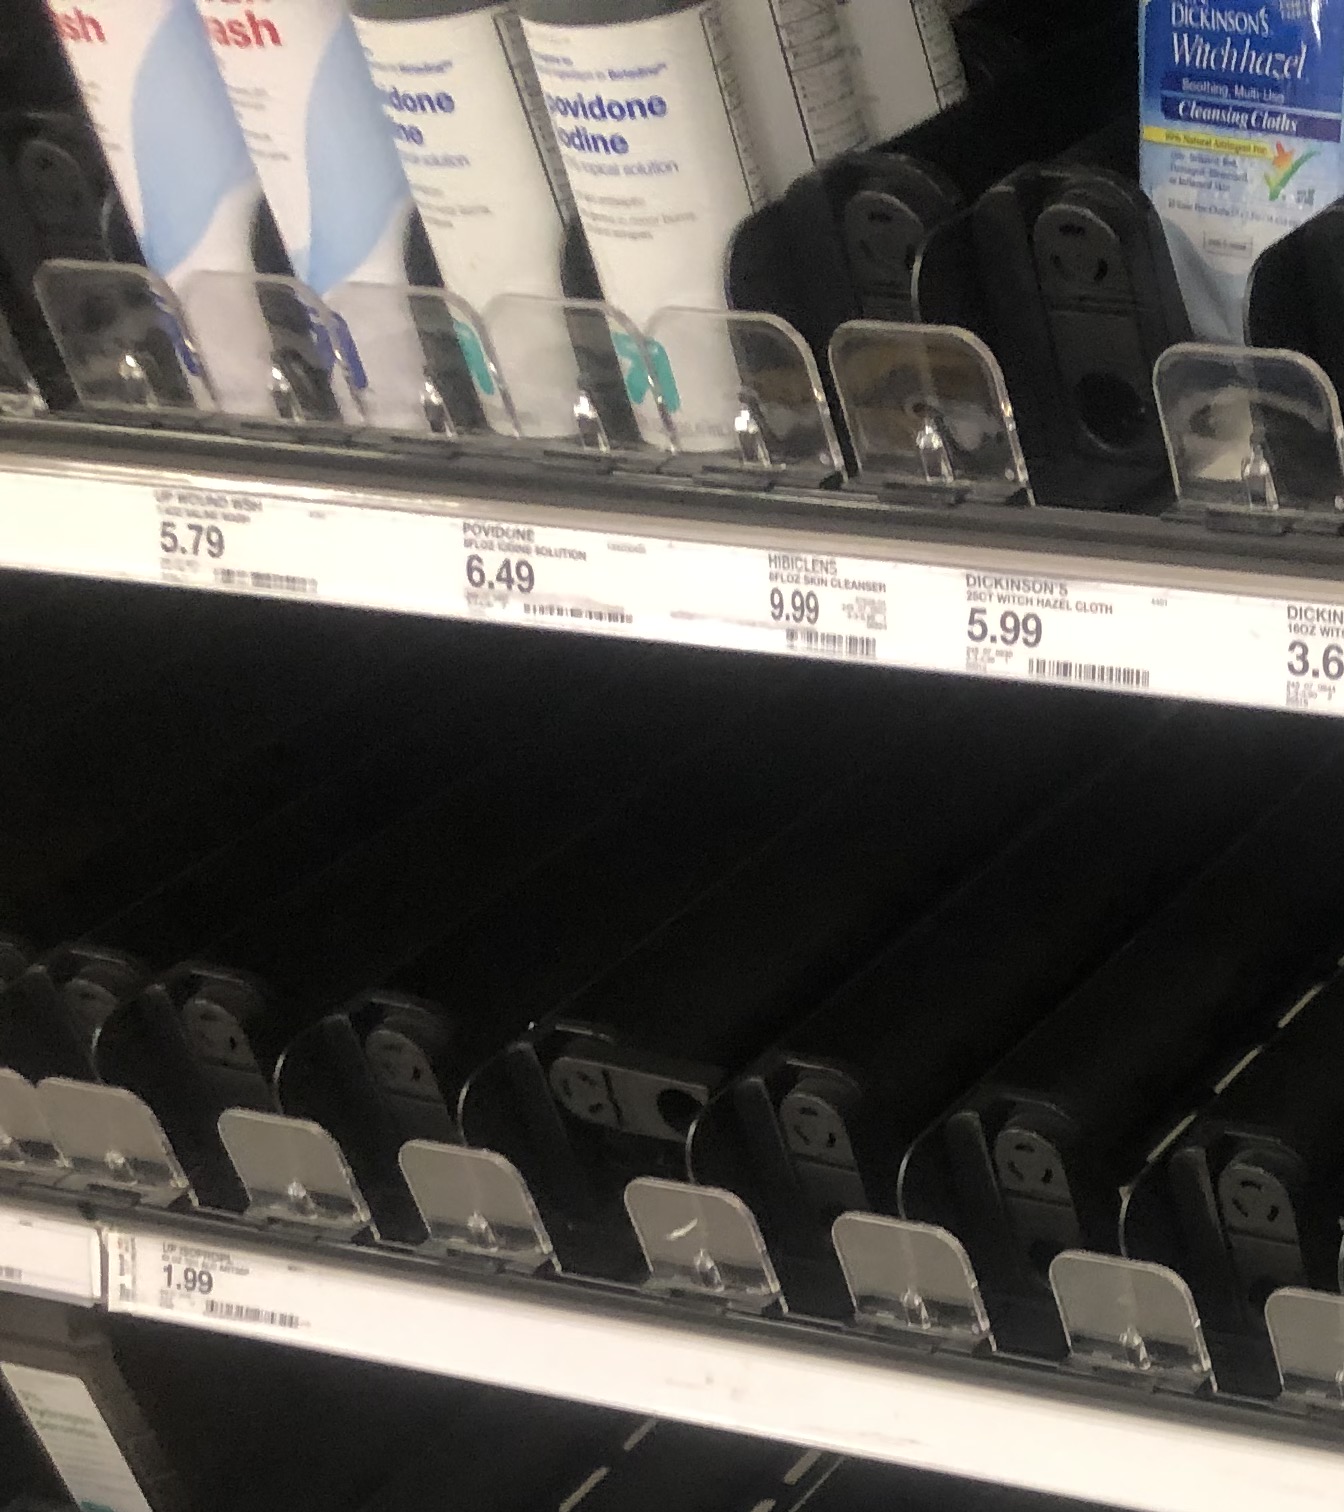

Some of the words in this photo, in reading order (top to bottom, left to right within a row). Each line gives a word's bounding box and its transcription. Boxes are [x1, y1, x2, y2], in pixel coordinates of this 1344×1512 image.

[1178, 99, 1250, 131] Cleansing
[1251, 110, 1298, 133] Cloths
[160, 520, 226, 559] 5.79
[465, 553, 535, 594] 6.49
[768, 553, 838, 577] HIBICLENS
[830, 578, 888, 594] CLEANSER
[965, 572, 1069, 598] DICKINSON'S
[769, 586, 820, 626] 9.99
[997, 591, 1034, 607] WITCH
[1035, 596, 1073, 612] HAZEL
[1075, 600, 1114, 615] CLOTH
[966, 606, 1043, 649] 5.99
[162, 1263, 214, 1295] 1.99
